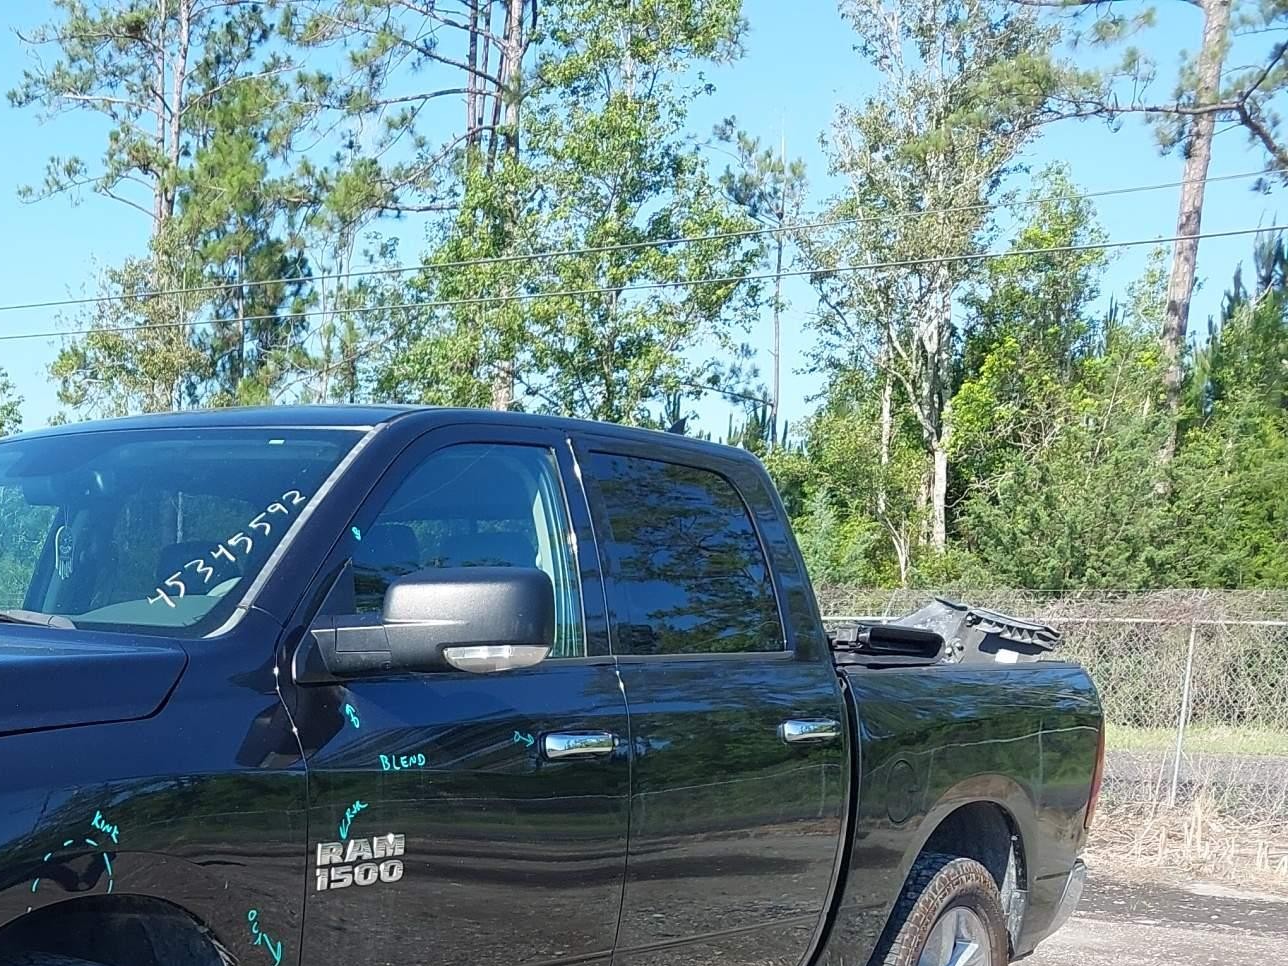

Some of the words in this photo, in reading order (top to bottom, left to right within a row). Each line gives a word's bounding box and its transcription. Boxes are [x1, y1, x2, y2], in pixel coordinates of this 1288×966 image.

[146, 489, 306, 608] 45345592
[379, 753, 426, 771] BLEND
[316, 833, 406, 867] RAM
[315, 858, 405, 892] 1500
